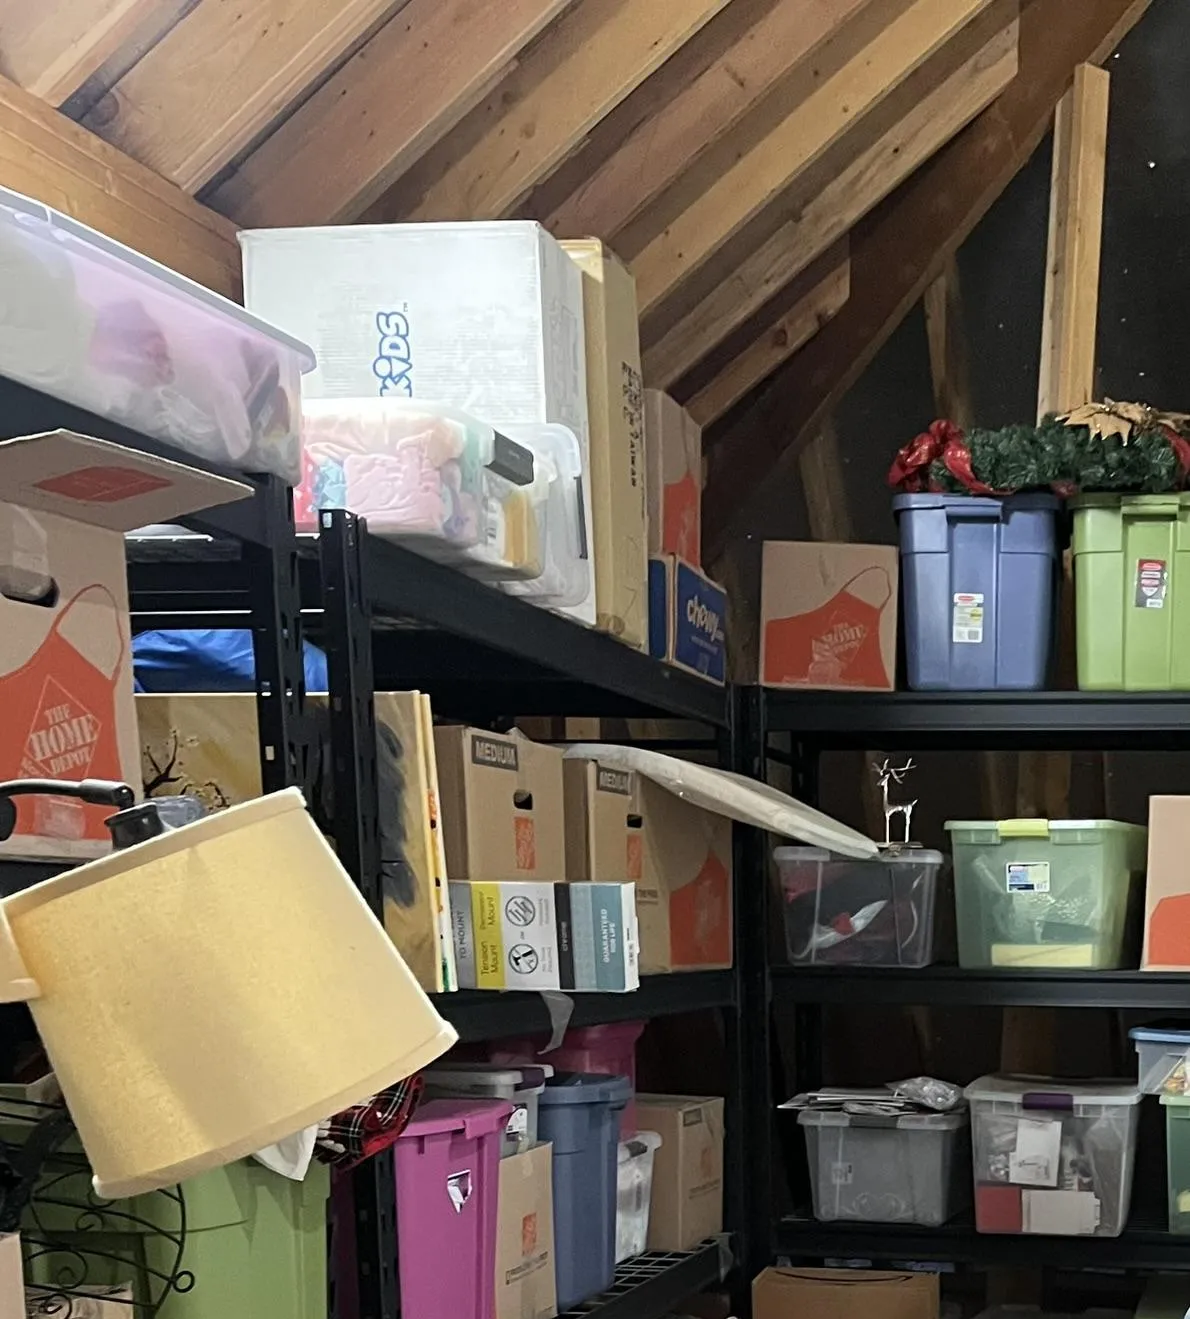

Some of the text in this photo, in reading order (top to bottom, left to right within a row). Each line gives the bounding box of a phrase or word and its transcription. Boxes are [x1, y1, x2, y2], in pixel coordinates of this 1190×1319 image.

[30, 713, 98, 761] HOME
[50, 746, 92, 776] DEPOT
[475, 740, 516, 766] MEDIUM
[486, 896, 496, 926] Mount
[456, 910, 466, 945] MOUNT
[479, 940, 490, 976] Tension
[489, 944, 499, 974] Mount
